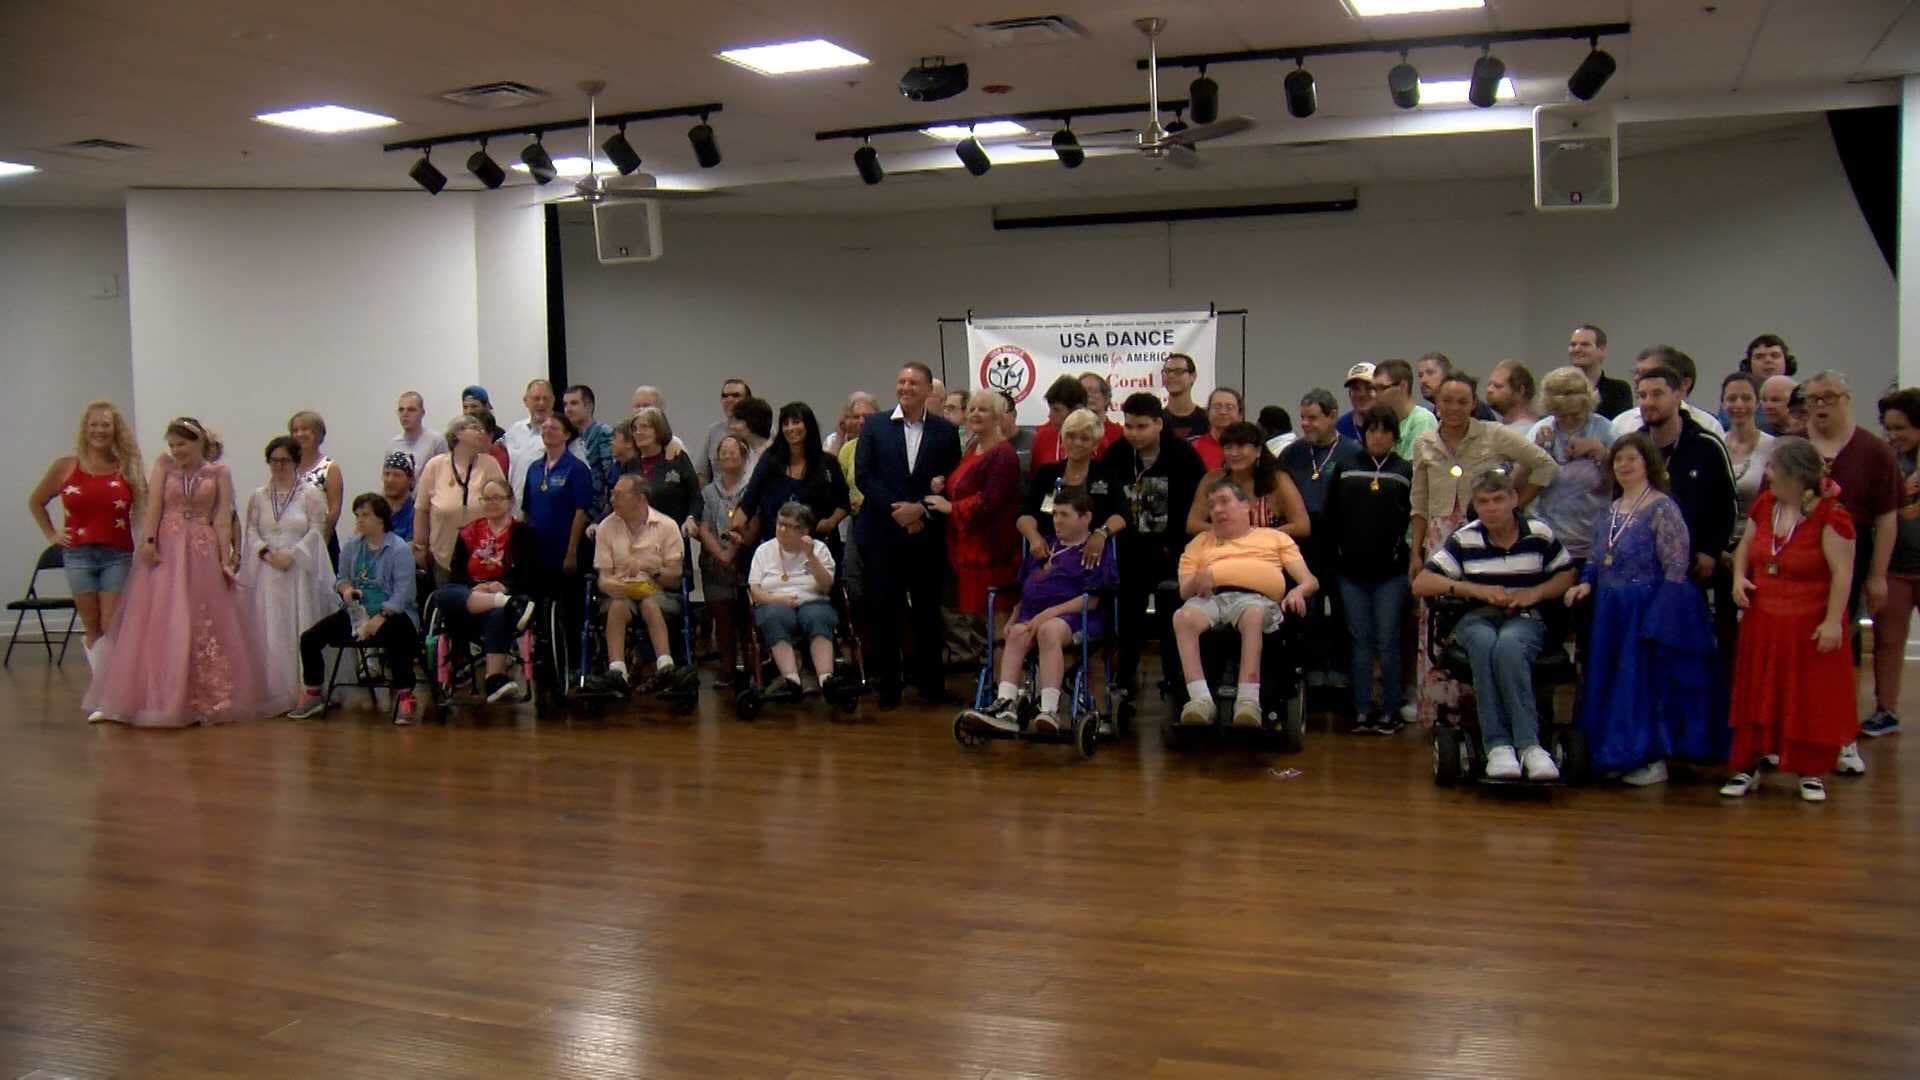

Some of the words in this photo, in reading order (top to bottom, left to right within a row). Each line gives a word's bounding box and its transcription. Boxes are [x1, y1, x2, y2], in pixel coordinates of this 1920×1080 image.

[1059, 332, 1100, 348] USA
[1106, 329, 1175, 347] DANCE
[1061, 353, 1109, 364] DANCING
[1105, 373, 1153, 388] Coral
